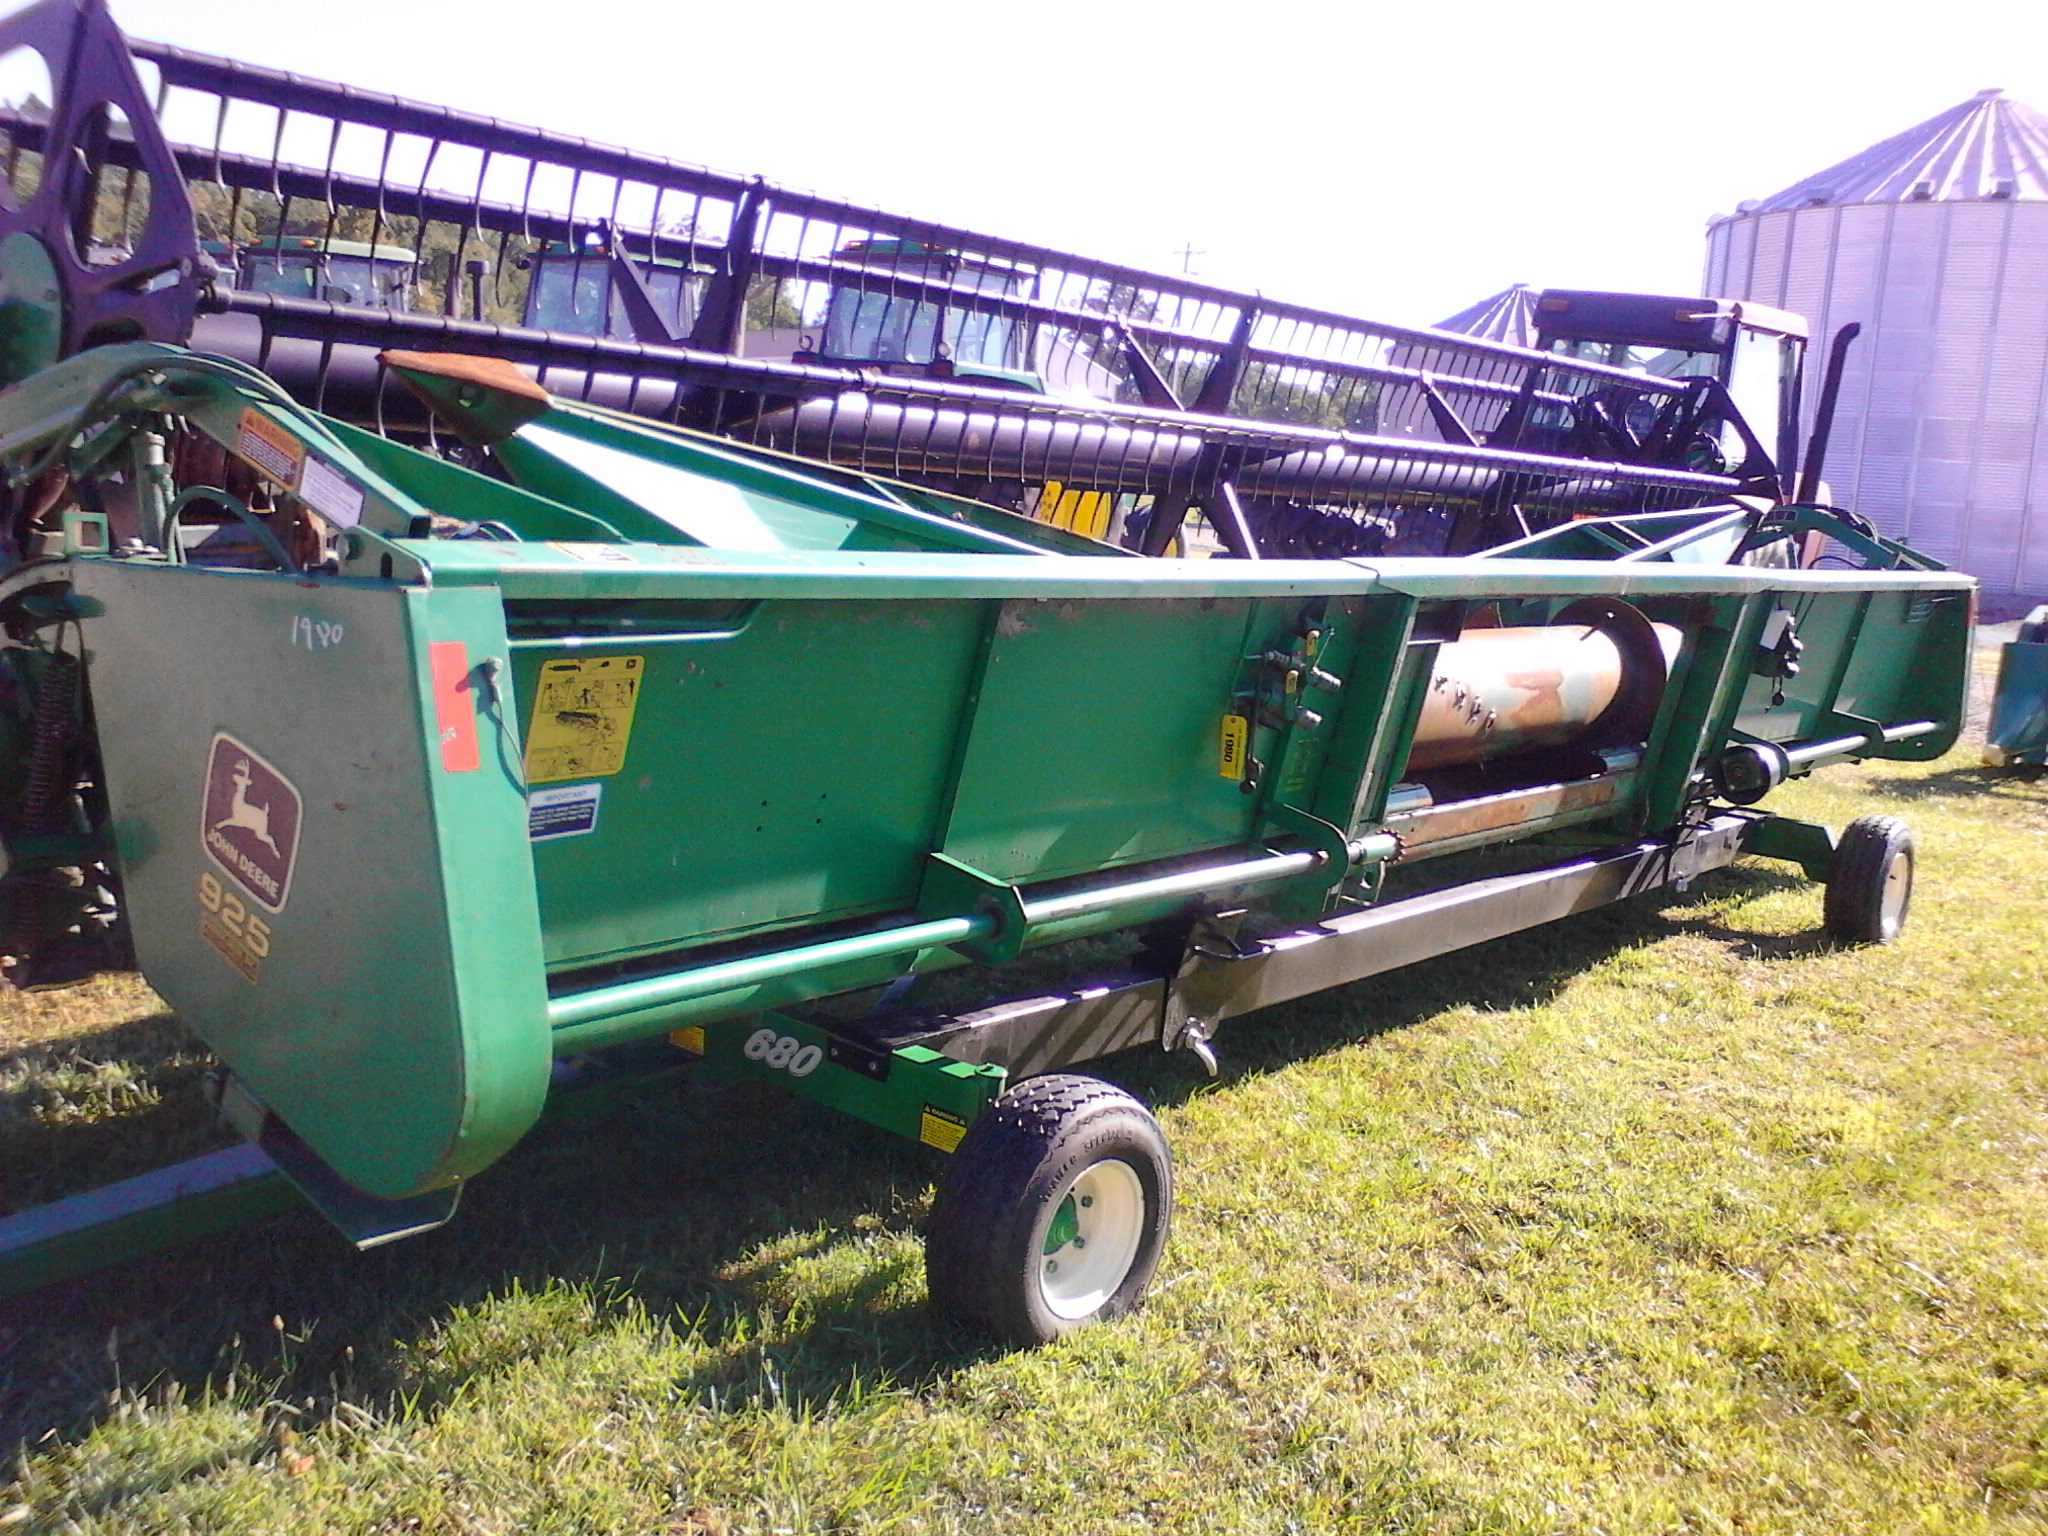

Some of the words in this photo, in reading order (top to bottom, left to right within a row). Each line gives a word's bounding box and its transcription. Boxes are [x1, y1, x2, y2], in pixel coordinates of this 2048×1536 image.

[207, 828, 239, 862] JOHN
[239, 854, 280, 899] DEERE
[199, 872, 271, 958] 925
[743, 1028, 823, 1078] 680
